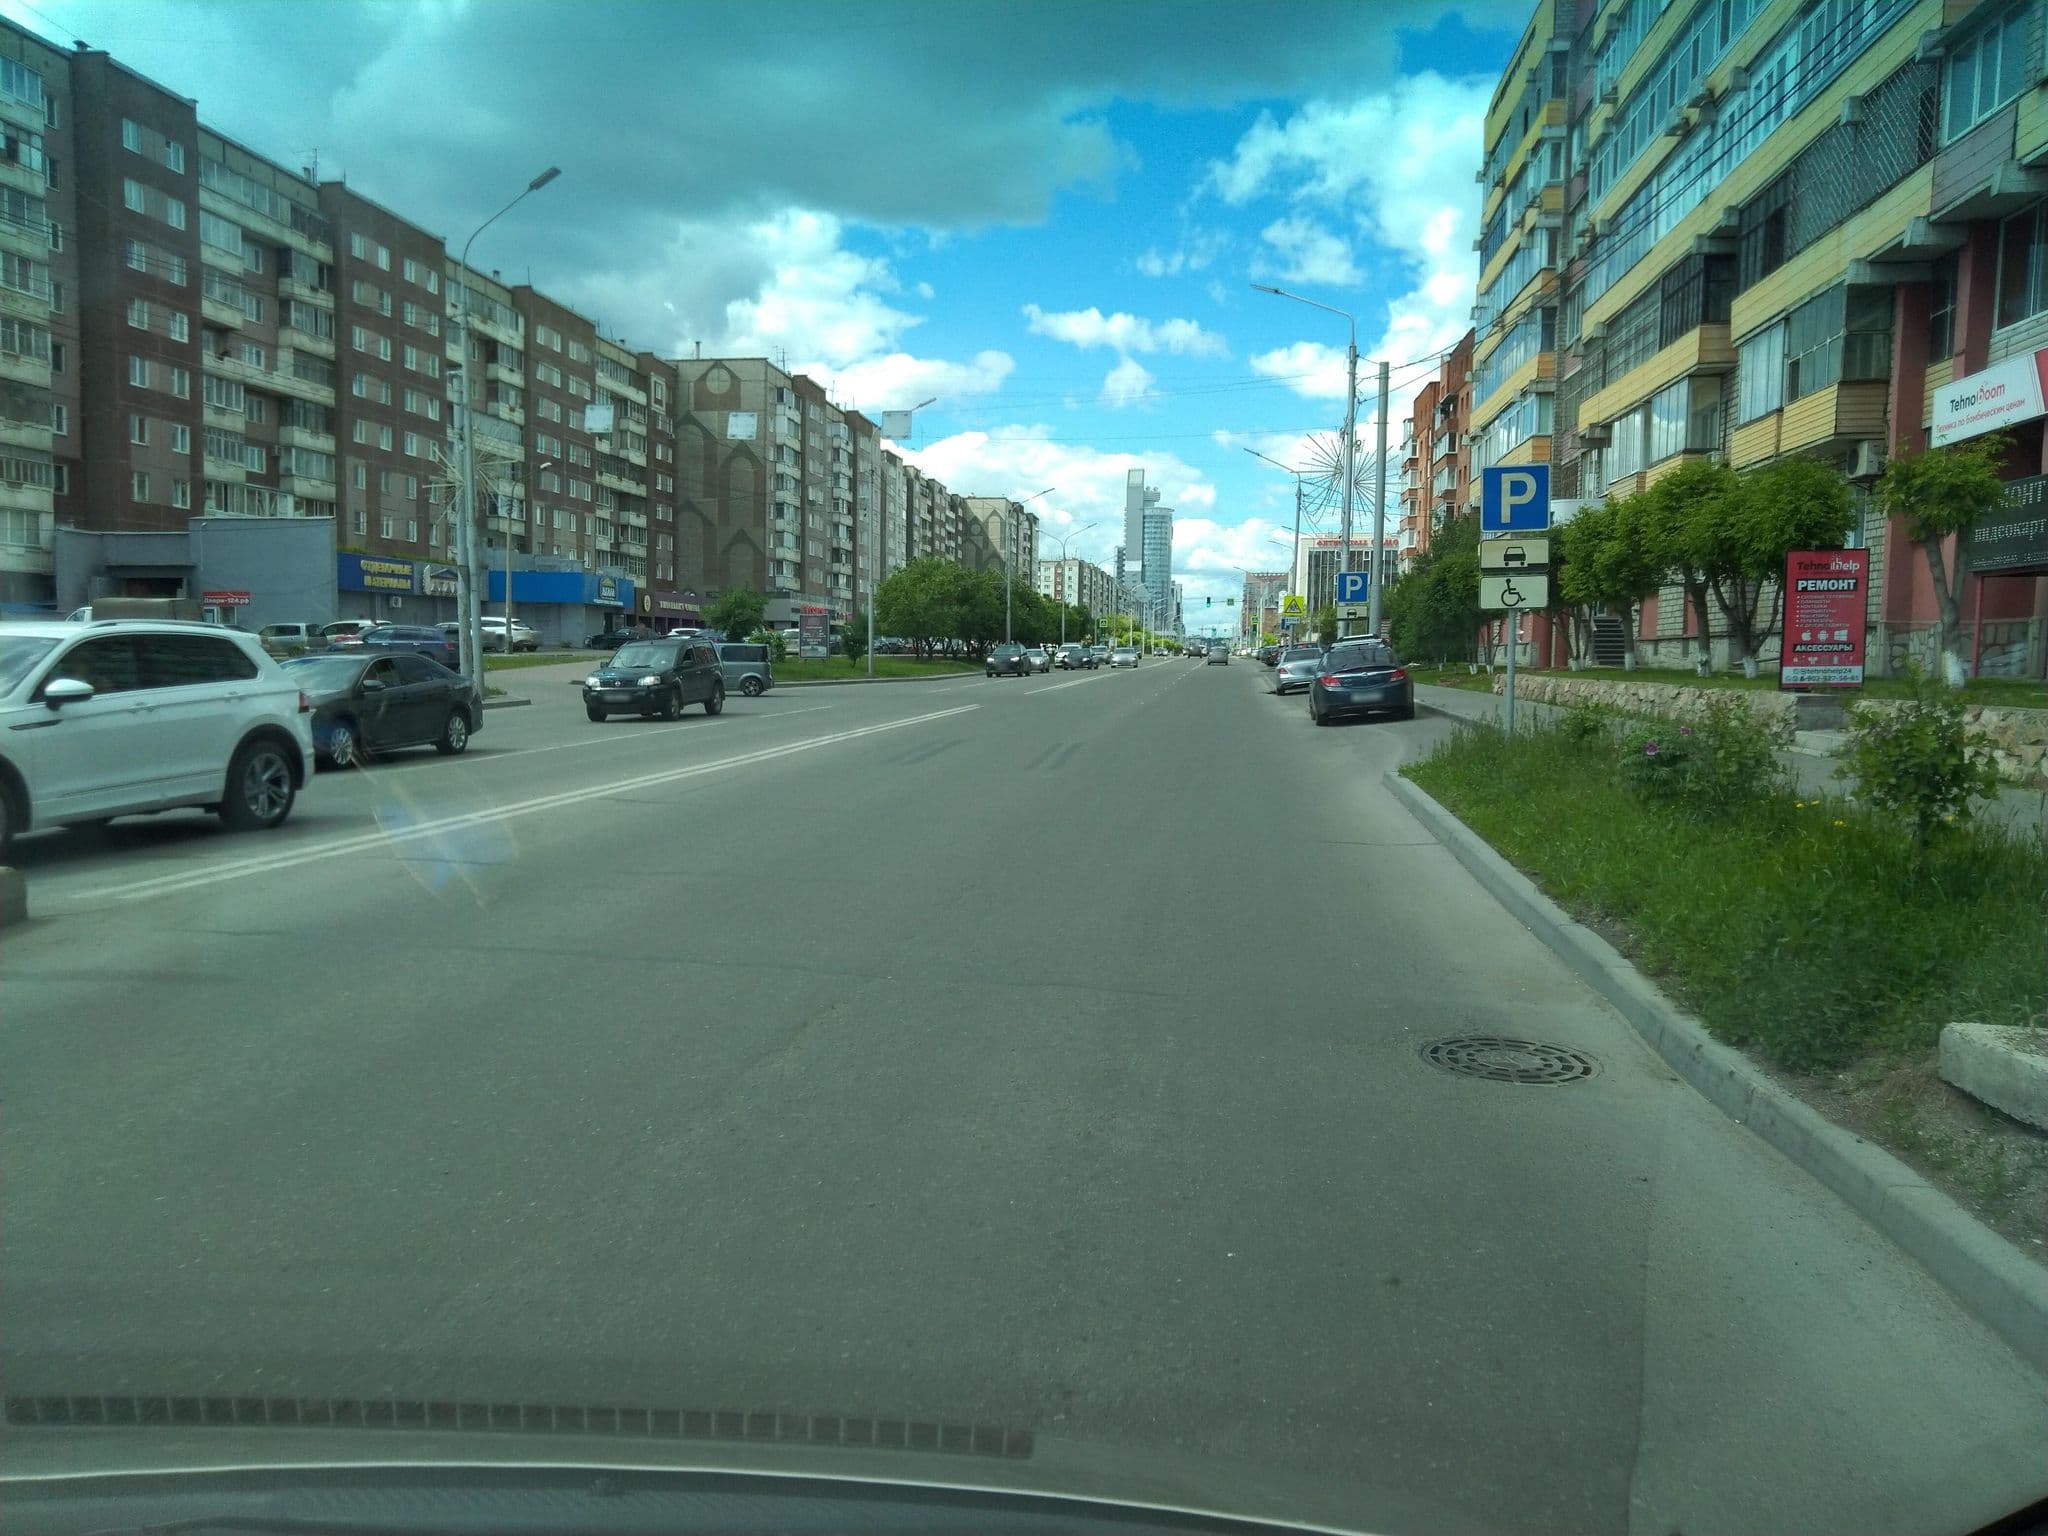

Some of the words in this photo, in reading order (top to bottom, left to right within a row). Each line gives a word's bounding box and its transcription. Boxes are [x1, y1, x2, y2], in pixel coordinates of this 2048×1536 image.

[1501, 472, 1537, 524] P
[1346, 576, 1363, 599] P
[1797, 579, 1856, 591] РЕМОНТ
[1795, 644, 1853, 652] АКСЕССУАРЫ
